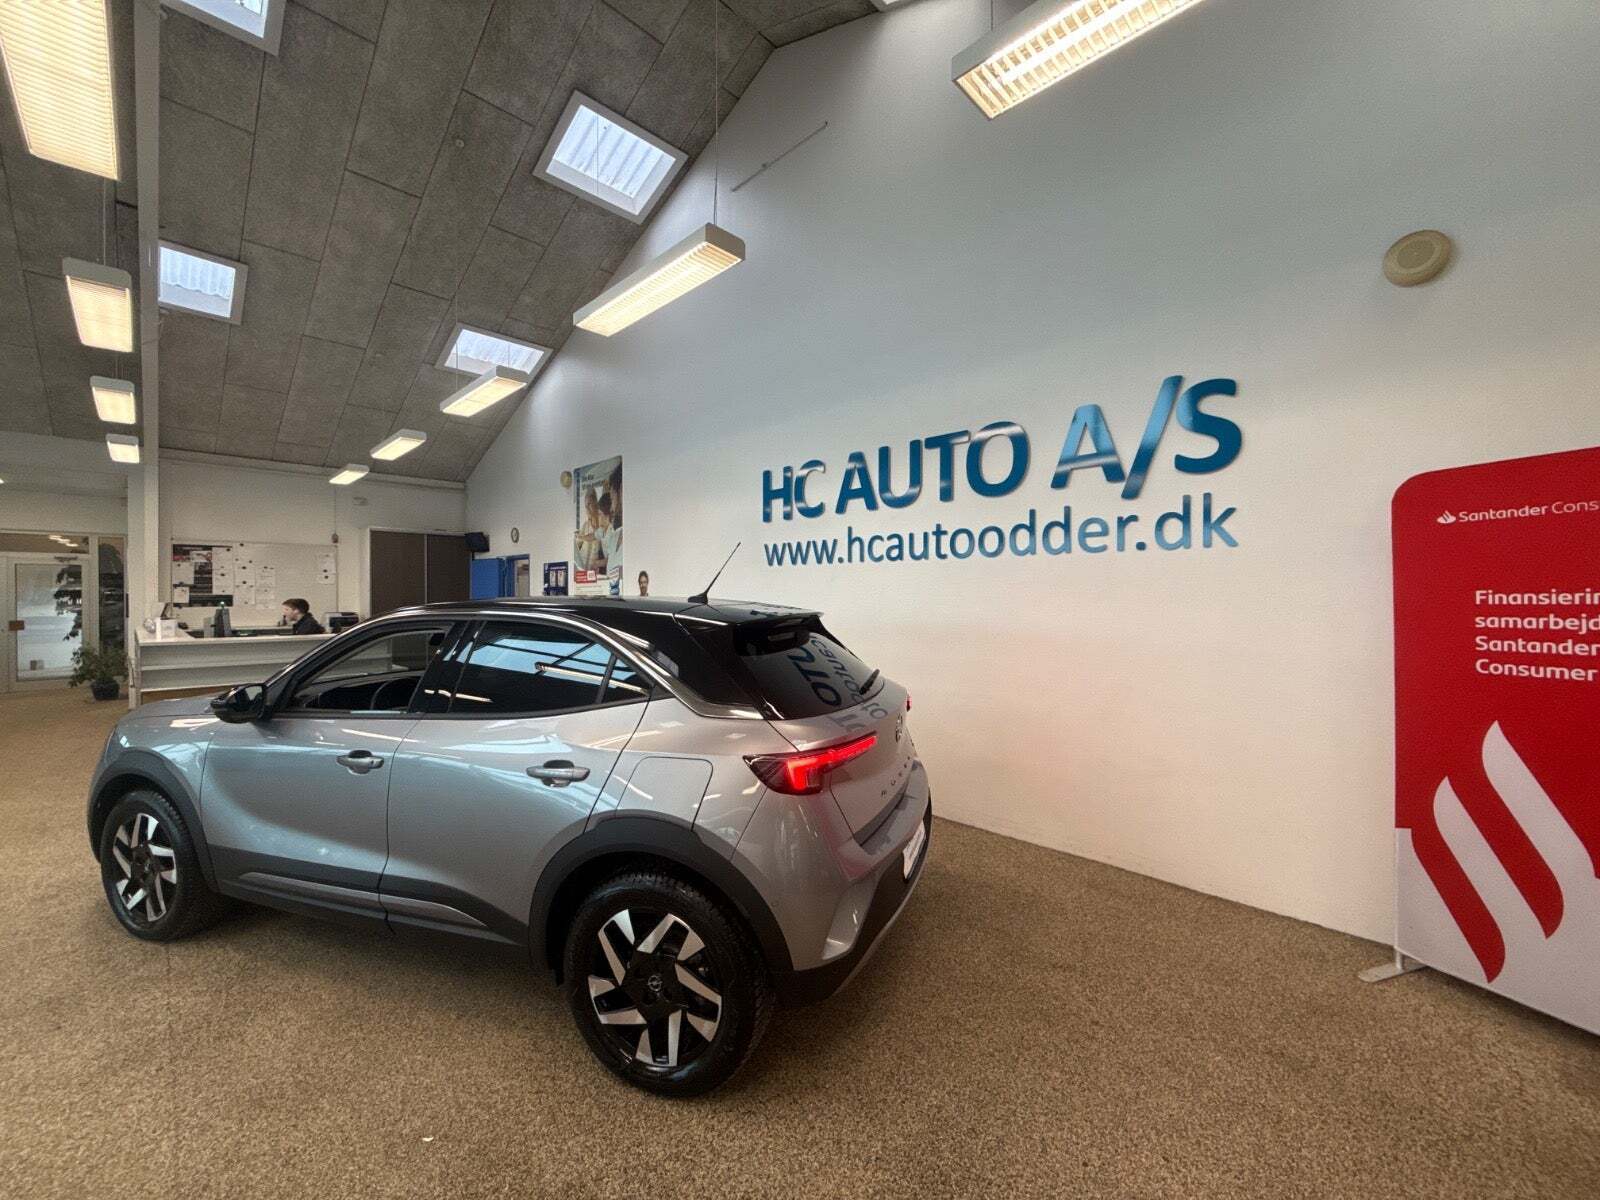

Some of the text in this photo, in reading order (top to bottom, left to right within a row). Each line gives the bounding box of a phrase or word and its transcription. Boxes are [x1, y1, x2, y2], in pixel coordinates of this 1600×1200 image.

[761, 375, 1243, 523] HC AUTO A/S
[1458, 505, 1549, 523] Santander
[763, 492, 1239, 567] www.hcautoodder.dk
[1475, 636, 1600, 656] Santander
[1475, 659, 1599, 682] Consumer
